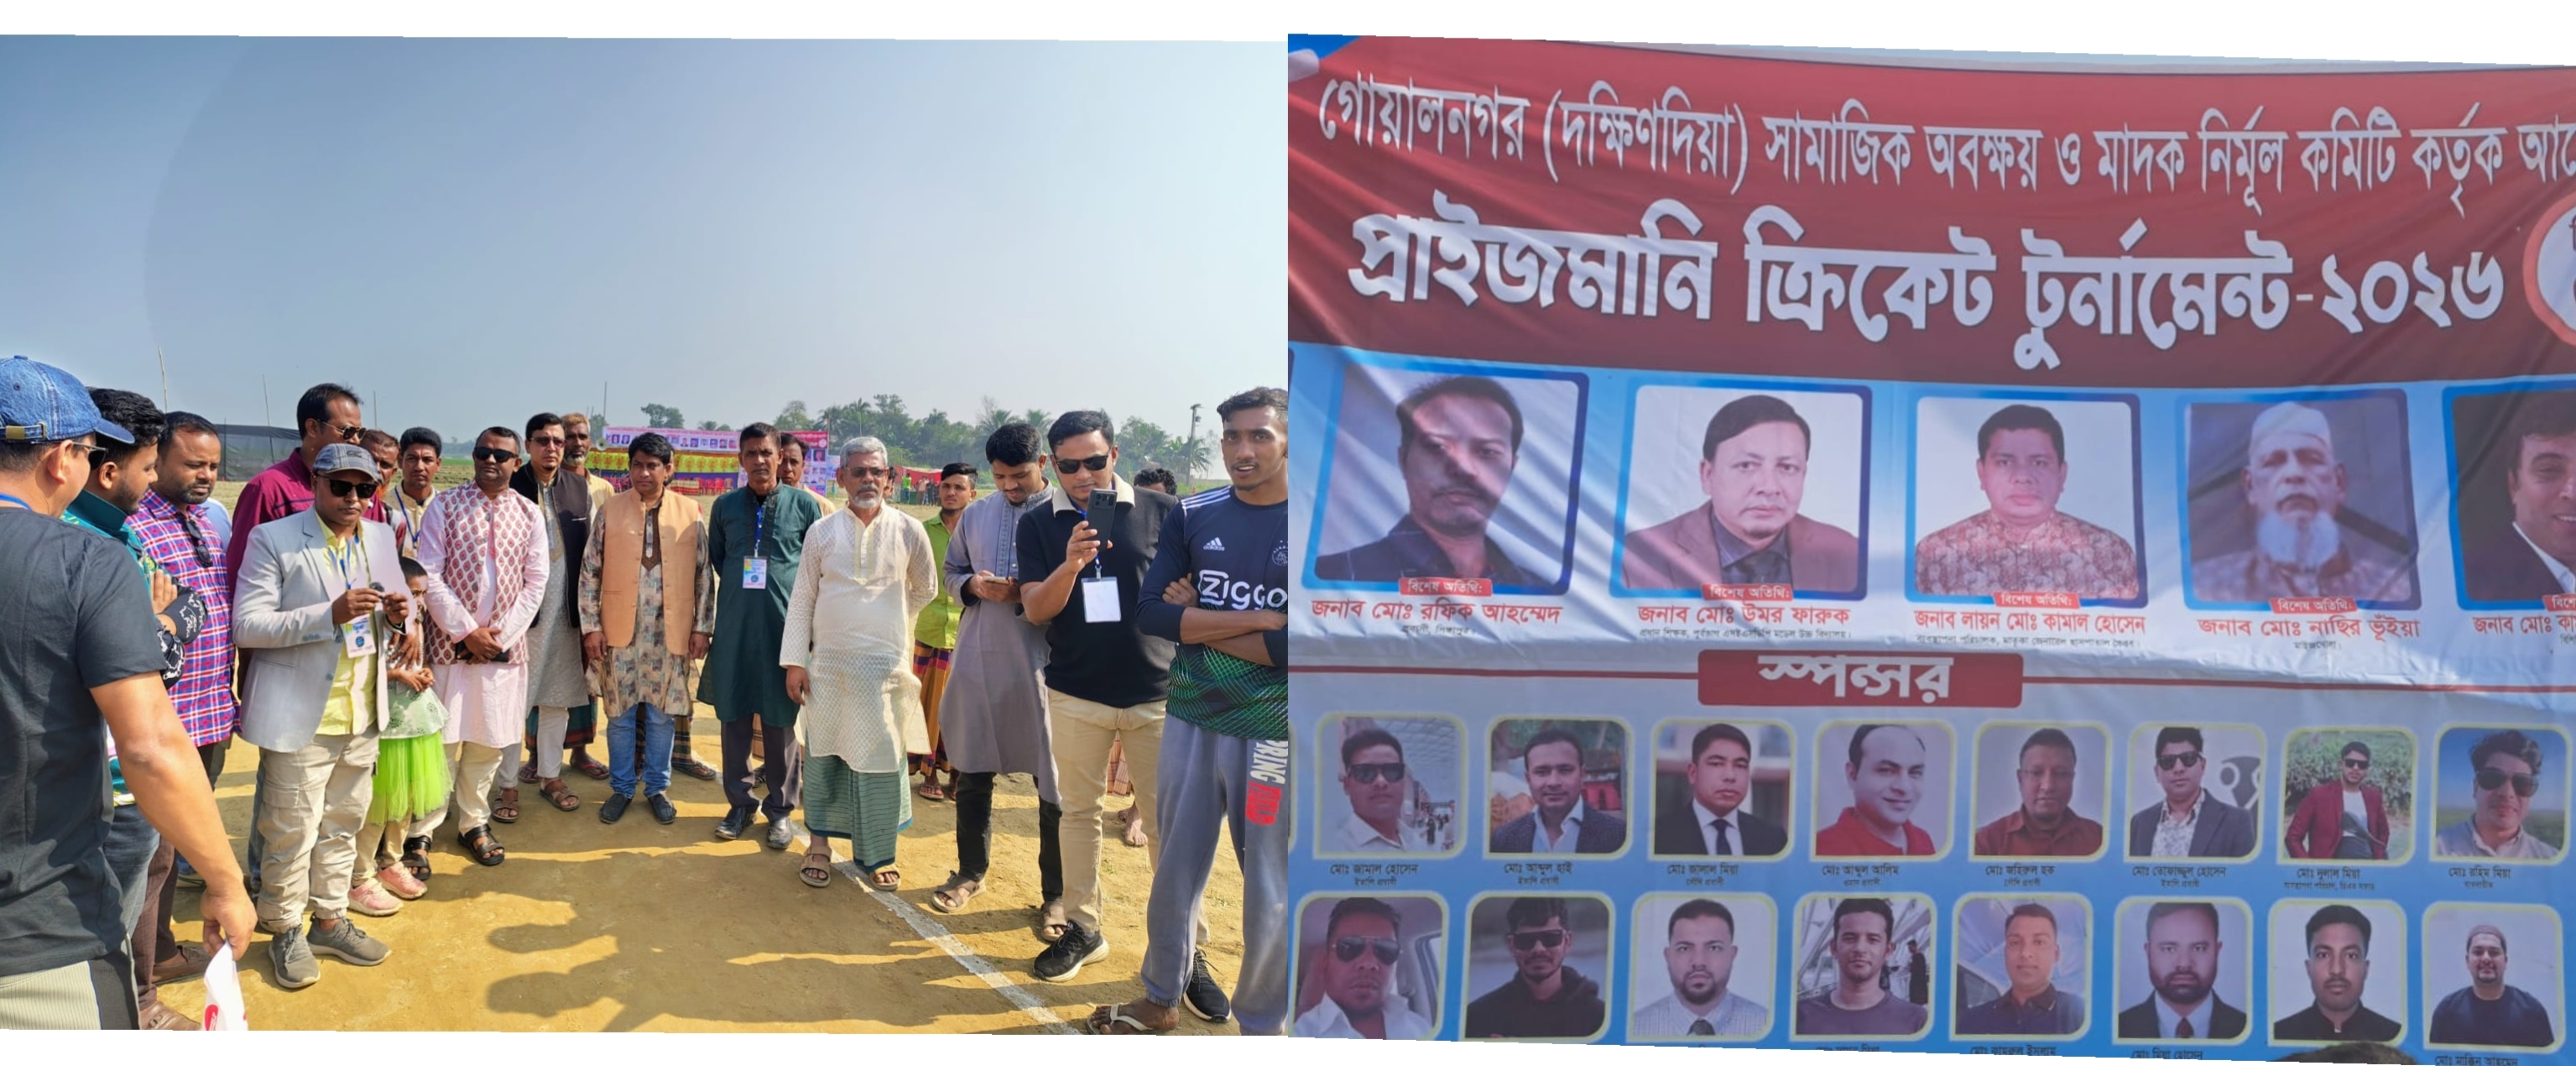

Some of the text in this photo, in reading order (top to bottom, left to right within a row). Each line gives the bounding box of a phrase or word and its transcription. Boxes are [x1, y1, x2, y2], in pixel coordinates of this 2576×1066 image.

[1319, 71, 1530, 161] গোয়ালনগর
[1543, 80, 1749, 195] (দক্ষিণদিয়া)
[1762, 97, 1916, 186] সামাজিক
[1923, 126, 2043, 191] অবক্ষয়
[2055, 133, 2081, 186] ও
[2094, 122, 2189, 194] মাদক
[2197, 105, 2288, 217] নির্মূল
[2297, 106, 2401, 194] কমিটি
[2410, 102, 2508, 218] কর্তৃক
[1348, 188, 1718, 321] প্রাইজমানি
[1744, 204, 1996, 342] ক্রিকেট
[1407, 579, 1440, 593] বিশেষ
[1709, 583, 1744, 598] বিশেষ
[2000, 593, 2032, 605] বিশেষ
[2277, 598, 2309, 611] বিশেষ
[1311, 597, 1563, 624] জনাব মোঃ রফিক আহম্মেদ
[1638, 601, 1851, 624] জনাব মোঃ উমর ফারুক
[1914, 609, 2146, 635] জনাব লায়ন মোঃ কামাল হোসেন
[2198, 614, 2421, 641] জনাব মোঃ নাছির ভূঁইয়া
[2472, 615, 2514, 635] জনাব
[2520, 615, 2552, 634] মোঃ
[1758, 655, 1954, 703] স্পন্সর
[1330, 864, 1349, 875] মোঃ
[1385, 864, 1419, 875] হোসেন
[1504, 863, 1522, 874] মোঃ
[1667, 865, 1685, 875] মোঃ
[1822, 865, 1840, 875] মোঃ
[1985, 865, 2003, 875] মোঃ
[2132, 866, 2150, 876] মোঃ
[2197, 866, 2226, 878] হোসেন
[2297, 868, 2313, 878] মোঃ
[2448, 867, 2466, 877] মোঃ
